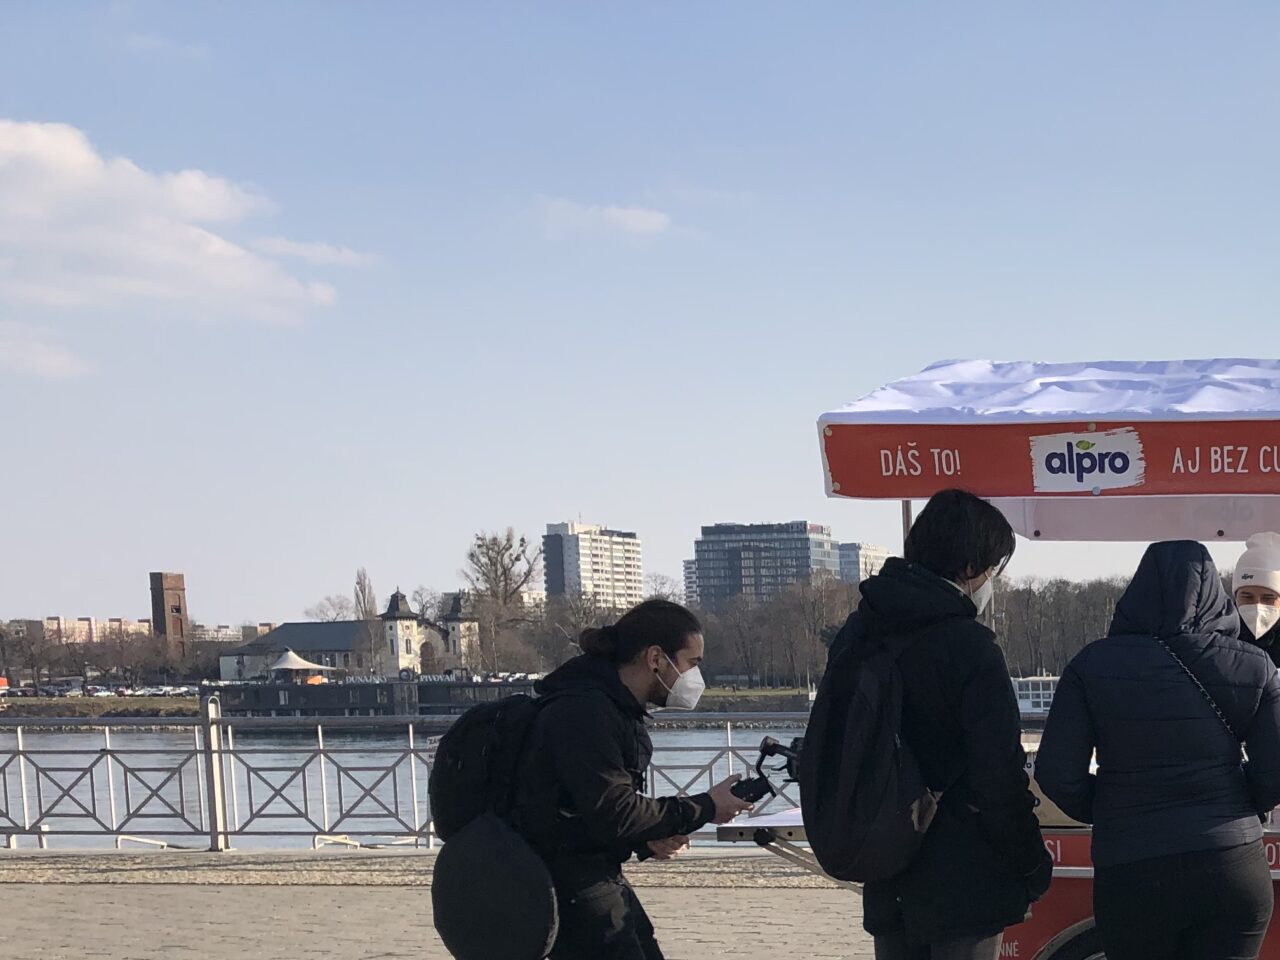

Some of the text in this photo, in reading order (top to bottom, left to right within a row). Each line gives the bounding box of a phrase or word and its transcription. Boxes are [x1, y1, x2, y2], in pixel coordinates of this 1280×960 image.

[880, 441, 961, 476] DÁŠ TO!
[1045, 441, 1130, 483] alpro
[1172, 446, 1200, 474] AJ
[1210, 445, 1249, 473] BEZ
